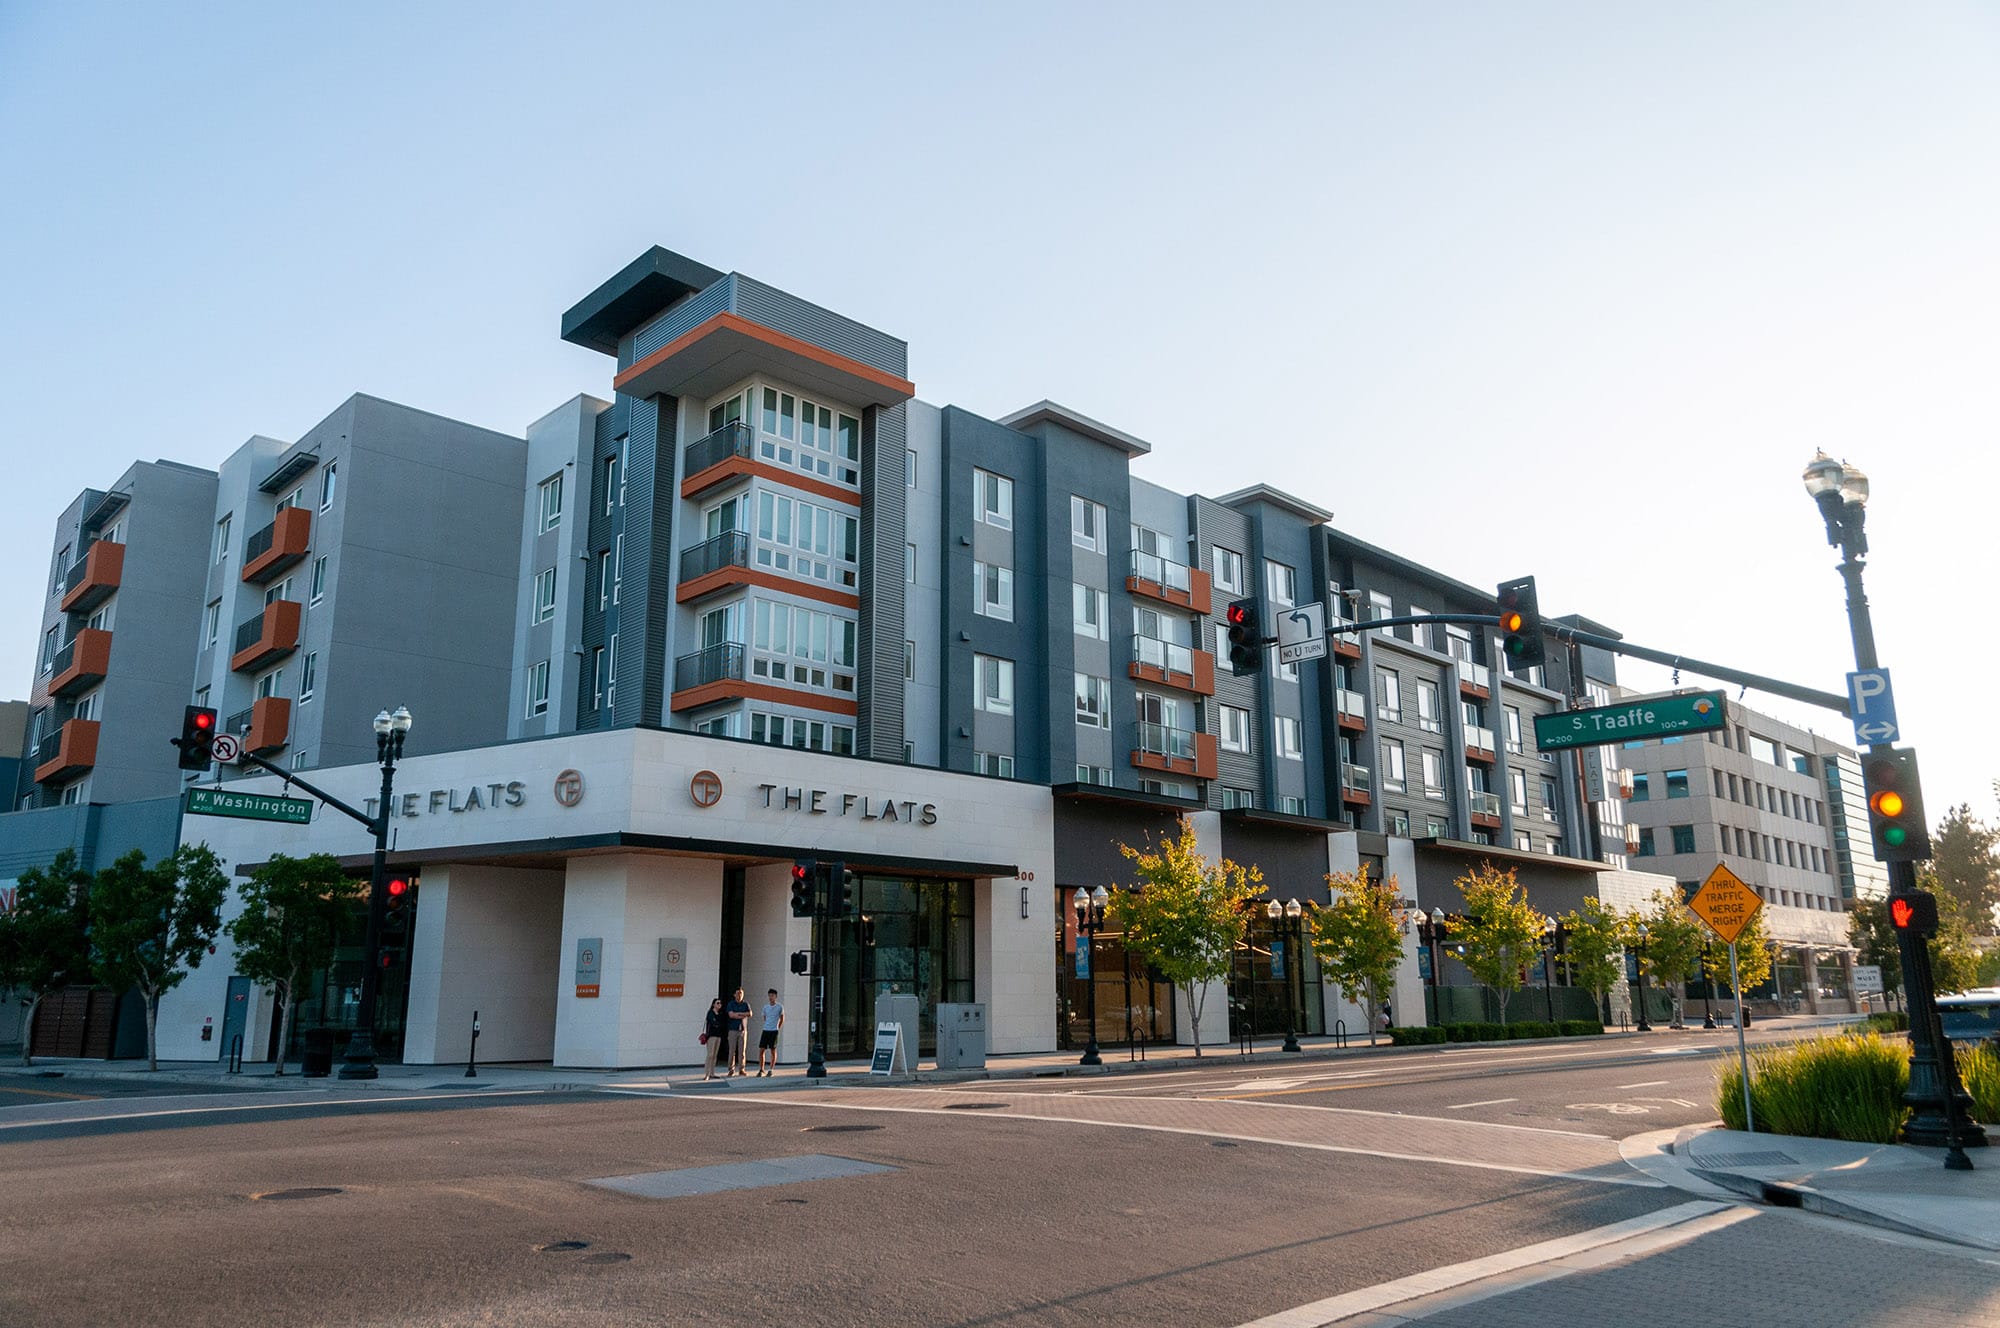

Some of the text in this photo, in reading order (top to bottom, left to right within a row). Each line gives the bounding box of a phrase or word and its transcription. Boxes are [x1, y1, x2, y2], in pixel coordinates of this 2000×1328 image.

[1283, 644, 1321, 658] NO U TURN
[1853, 674, 1885, 714] P
[1572, 709, 1655, 731] S. Taaffe
[1661, 721, 1677, 729] 100
[1555, 735, 1572, 743] 200
[1588, 752, 1600, 796] FLATS
[196, 793, 305, 815] W. Washington
[429, 781, 526, 814] FLATS
[759, 784, 937, 825] THE FLATS
[1711, 880, 1735, 890] THRU
[1705, 891, 1744, 902] TRAFFIC
[1709, 903, 1745, 914] MERGE
[1713, 916, 1743, 926] RIGHT
